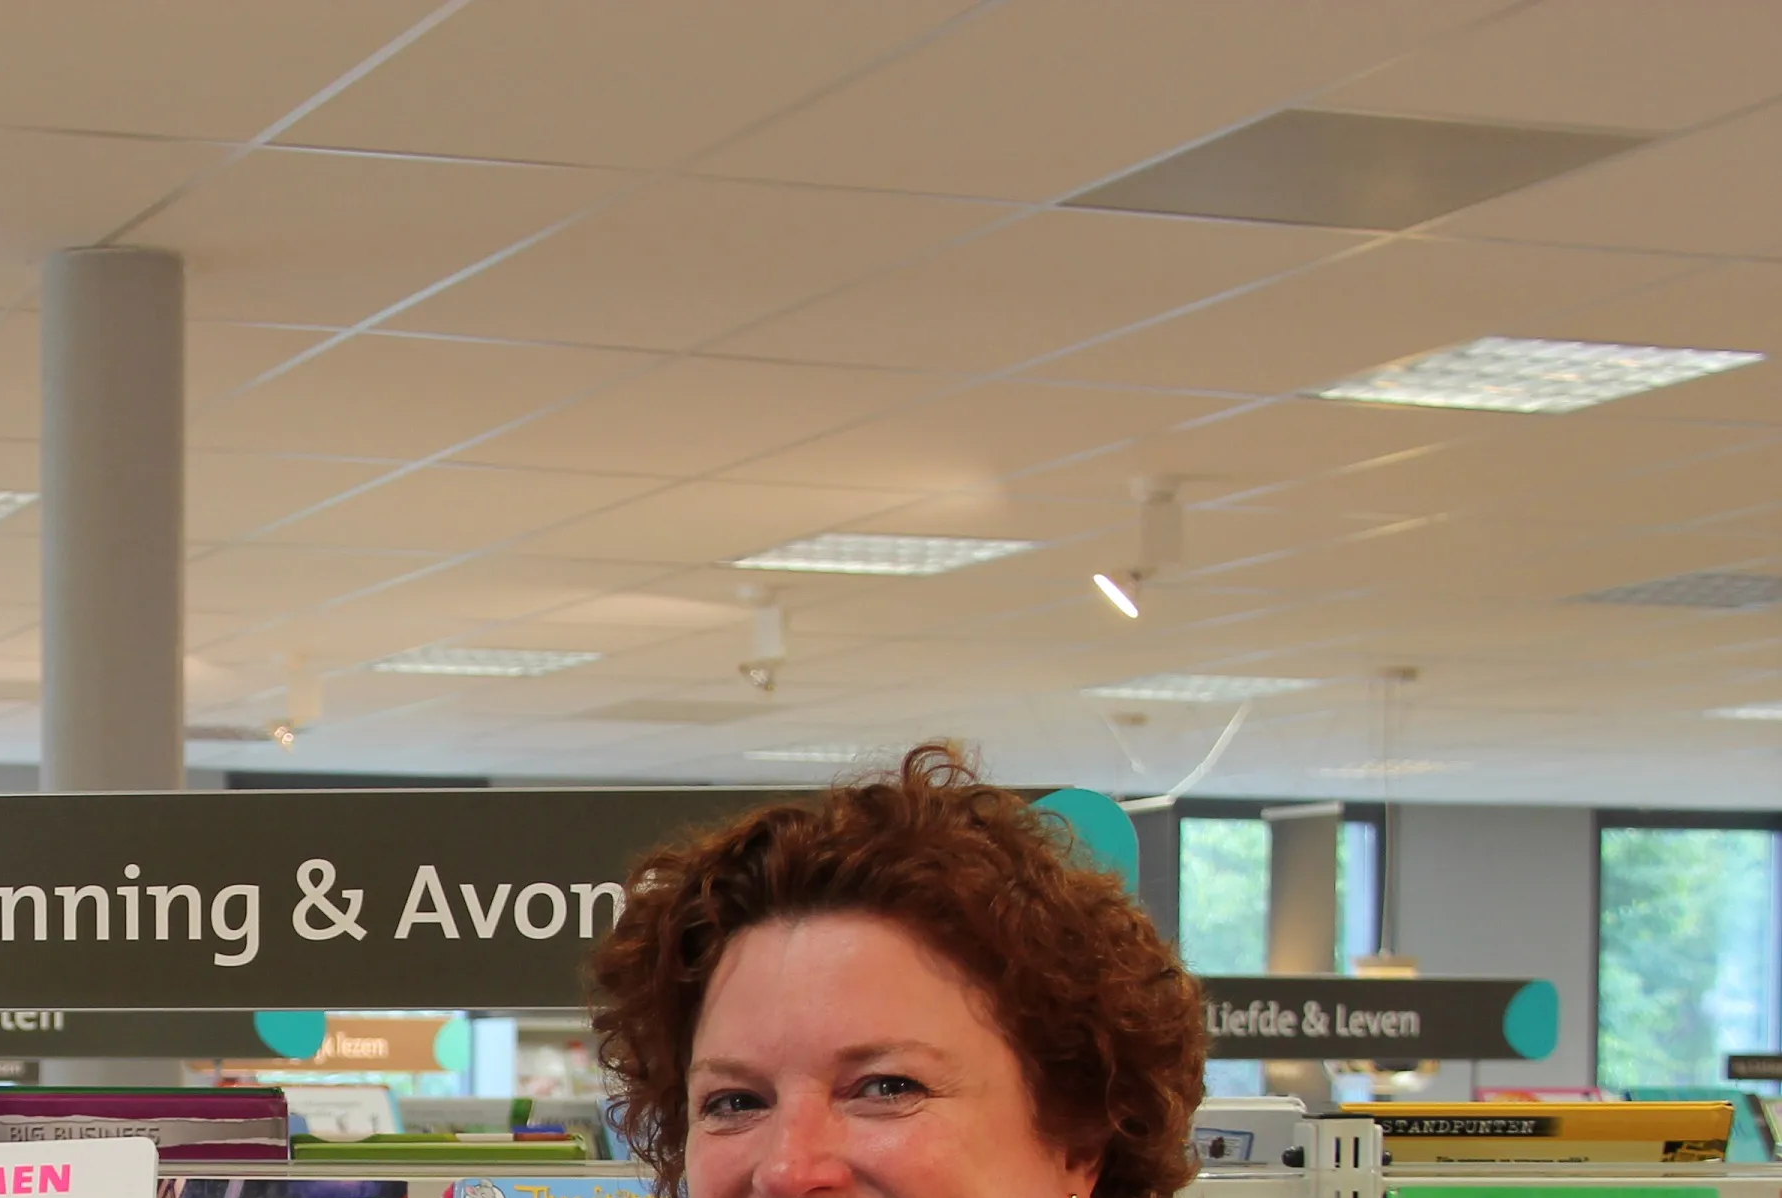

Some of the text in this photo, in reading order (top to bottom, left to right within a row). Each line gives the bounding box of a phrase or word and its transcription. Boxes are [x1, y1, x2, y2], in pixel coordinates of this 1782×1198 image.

[291, 858, 367, 941] &
[1205, 1000, 1421, 1037] Liefde & Leven
[1382, 1120, 1536, 1134] STANDPUNTEN
